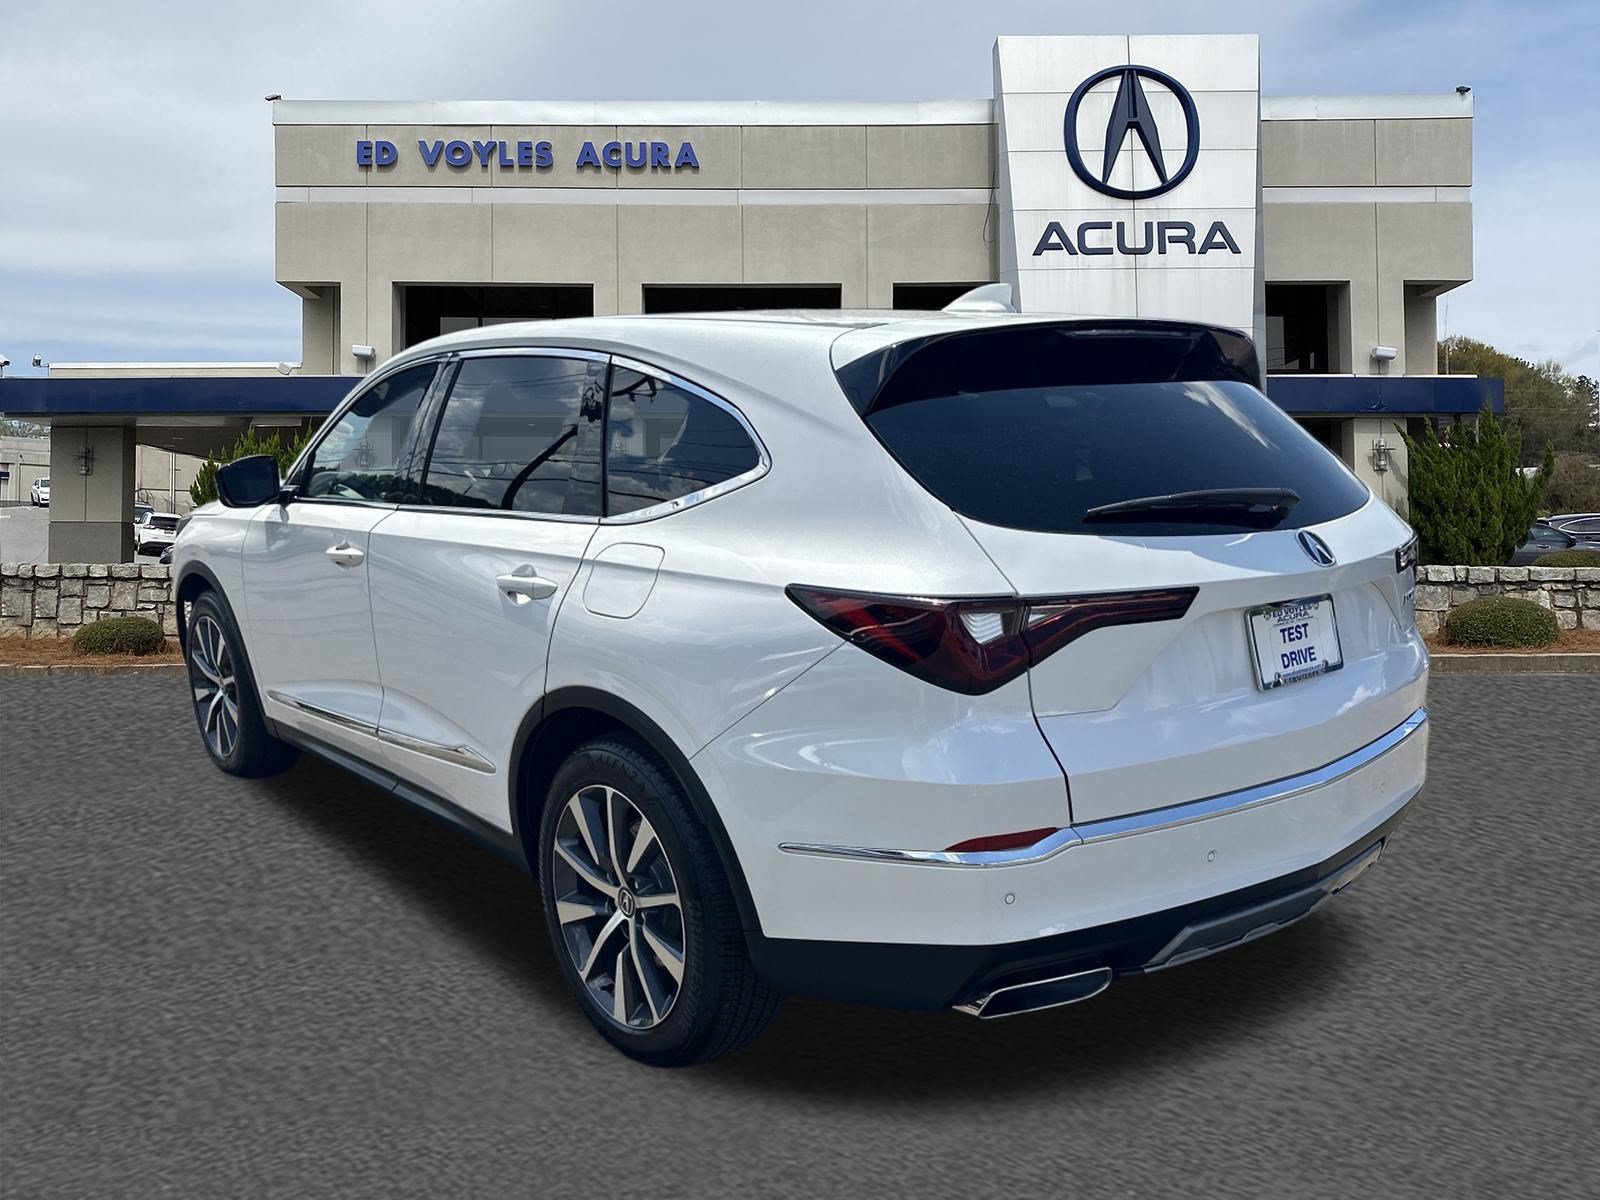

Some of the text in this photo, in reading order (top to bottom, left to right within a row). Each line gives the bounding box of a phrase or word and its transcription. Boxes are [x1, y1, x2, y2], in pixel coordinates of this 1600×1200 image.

[356, 140, 700, 169] ED VOYLES ACURA
[1032, 221, 1242, 256] ACURA
[1280, 623, 1309, 643] TEST
[1281, 646, 1317, 669] DRIVE
